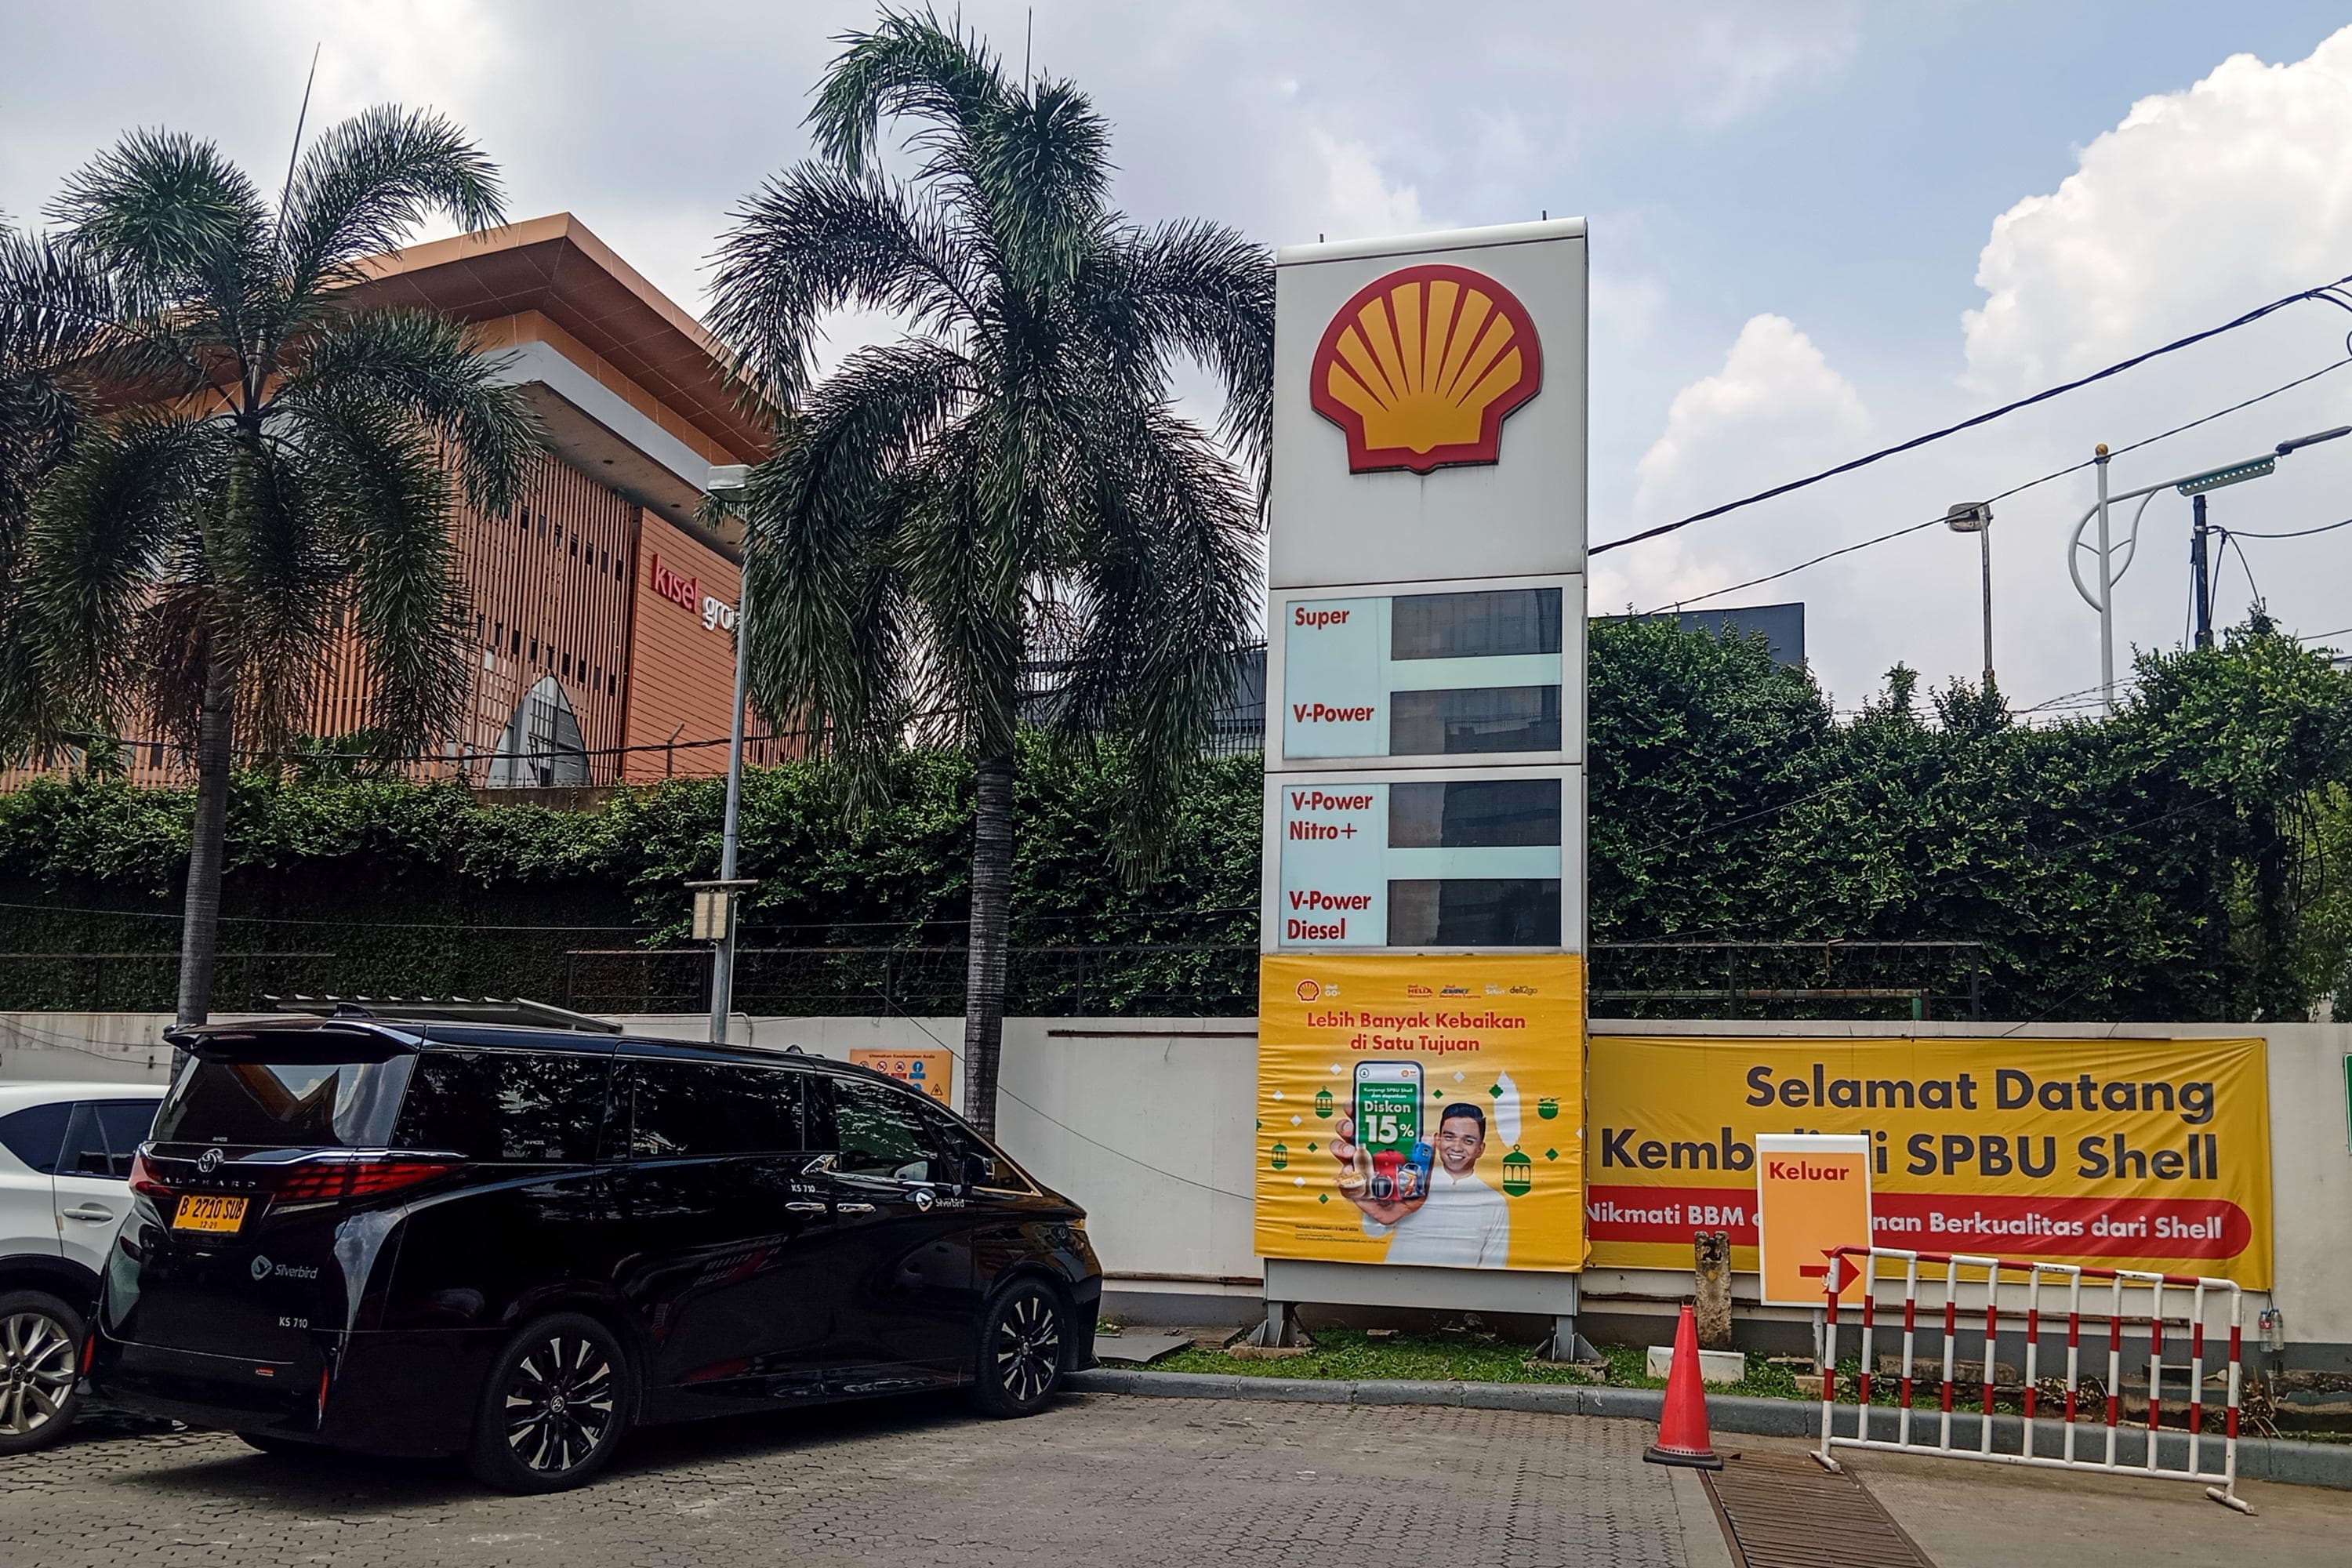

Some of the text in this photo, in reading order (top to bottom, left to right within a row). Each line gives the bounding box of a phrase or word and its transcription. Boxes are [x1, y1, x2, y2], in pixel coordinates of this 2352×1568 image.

[651, 553, 698, 615] kisel
[1294, 607, 1350, 629] Super
[1293, 703, 1374, 723] V-Power
[1290, 791, 1374, 811] V-Power
[1289, 821, 1358, 840] Nitro+
[1289, 891, 1371, 911] V-Power
[1287, 918, 1345, 940] Diesel
[1509, 985, 1538, 996] deli2go
[1307, 1011, 1526, 1033] Lebih Banyak Kebaikan
[1350, 1034, 1479, 1055] di Satu Tujuan
[1746, 1063, 2215, 1124] Selamat Datang
[1364, 1100, 1411, 1113] Diskon
[1602, 1127, 1820, 1171] Kemb
[1907, 1134, 2056, 1178] SPBU
[2077, 1134, 2218, 1179] Shell
[1769, 1161, 1849, 1181] Keluar
[791, 1184, 816, 1193] KS 710
[180, 1197, 245, 1220] B 2710 SUB
[935, 1197, 965, 1208] Silverbird
[1586, 1201, 1681, 1224] Nikmati
[1688, 1205, 1744, 1226] BBM
[1930, 1211, 2084, 1236] Berkualitas
[2091, 1214, 2147, 1237] dari
[2154, 1216, 2222, 1239] Shell
[274, 1264, 318, 1279] Silverbird
[279, 1316, 308, 1329] KS 710
